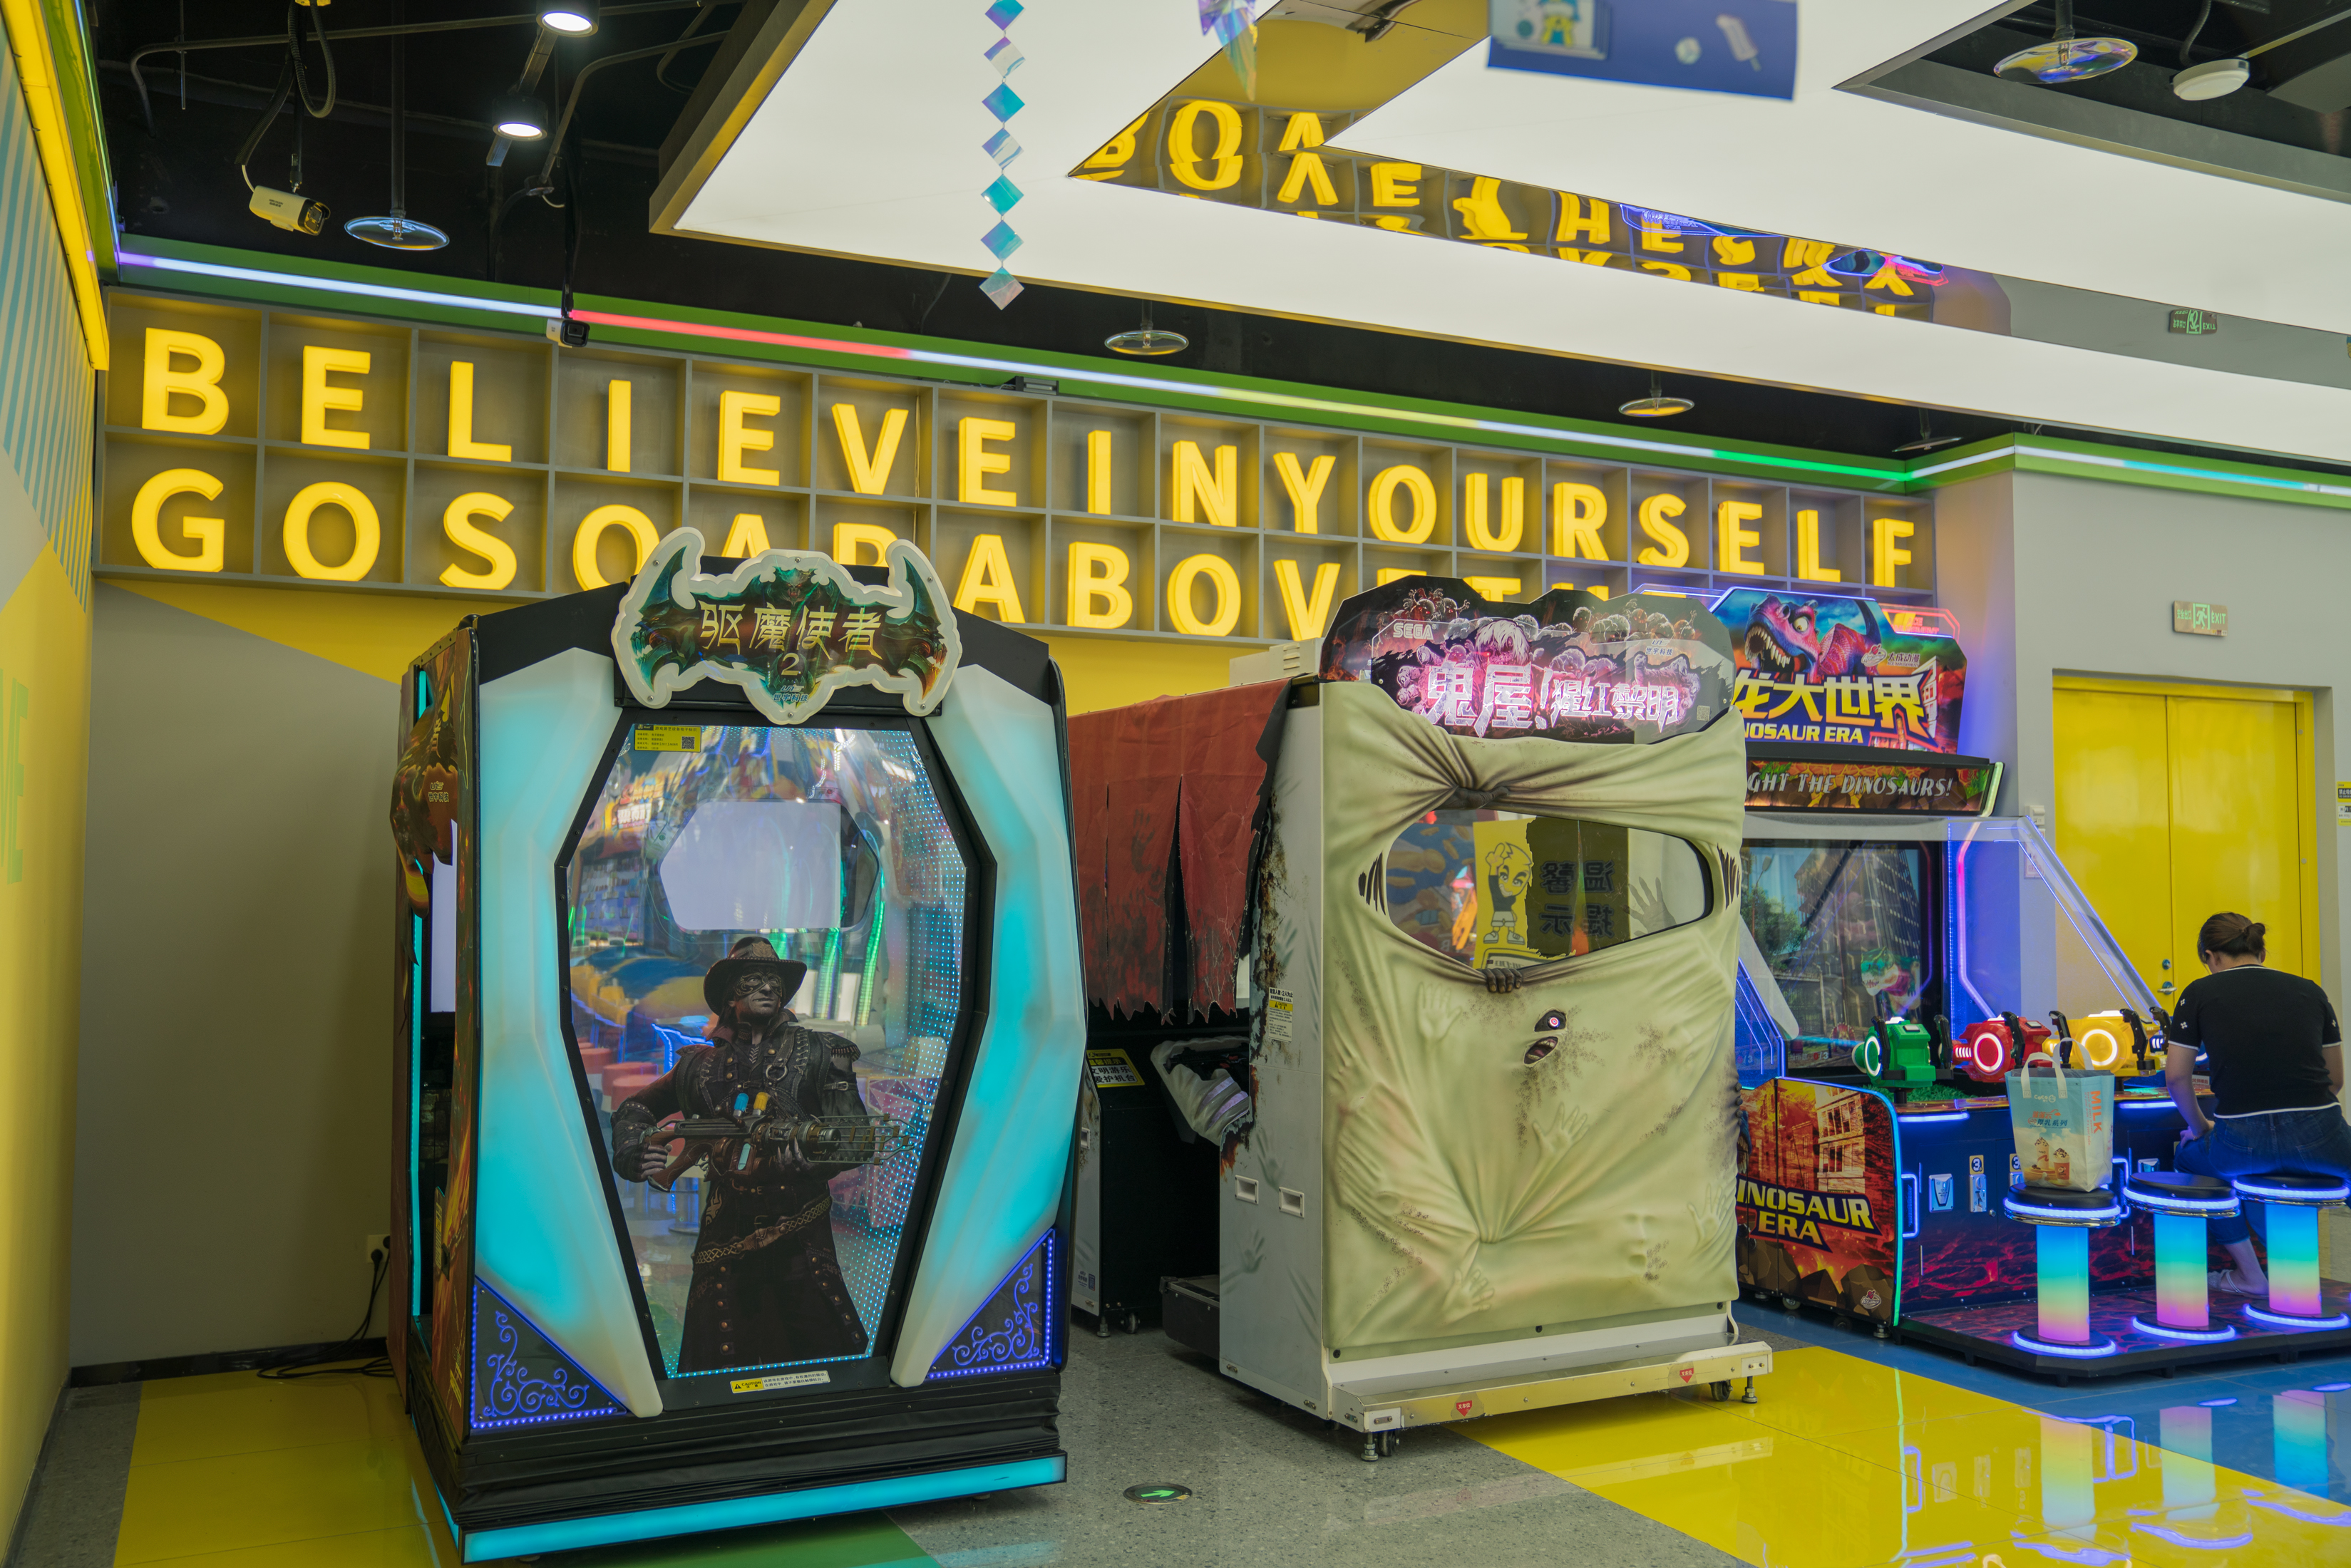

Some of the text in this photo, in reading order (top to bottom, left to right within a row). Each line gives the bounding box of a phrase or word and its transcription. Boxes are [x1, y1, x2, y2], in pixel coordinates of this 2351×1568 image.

[2211, 612, 2226, 624] EXIT
[699, 601, 883, 661] 驱魔使者
[1392, 622, 1434, 640] SEGA
[1645, 647, 1673, 656] 世宇科技
[1888, 652, 1920, 663] 大成动漫
[781, 652, 800, 676] 2
[773, 693, 809, 702] 世宇科技
[1824, 726, 1863, 743] ERA
[1797, 773, 1836, 794] THE
[1841, 775, 1953, 797] DINOSAURS!
[2090, 1090, 2102, 1134] MILK
[1758, 1210, 1823, 1246] ERA
